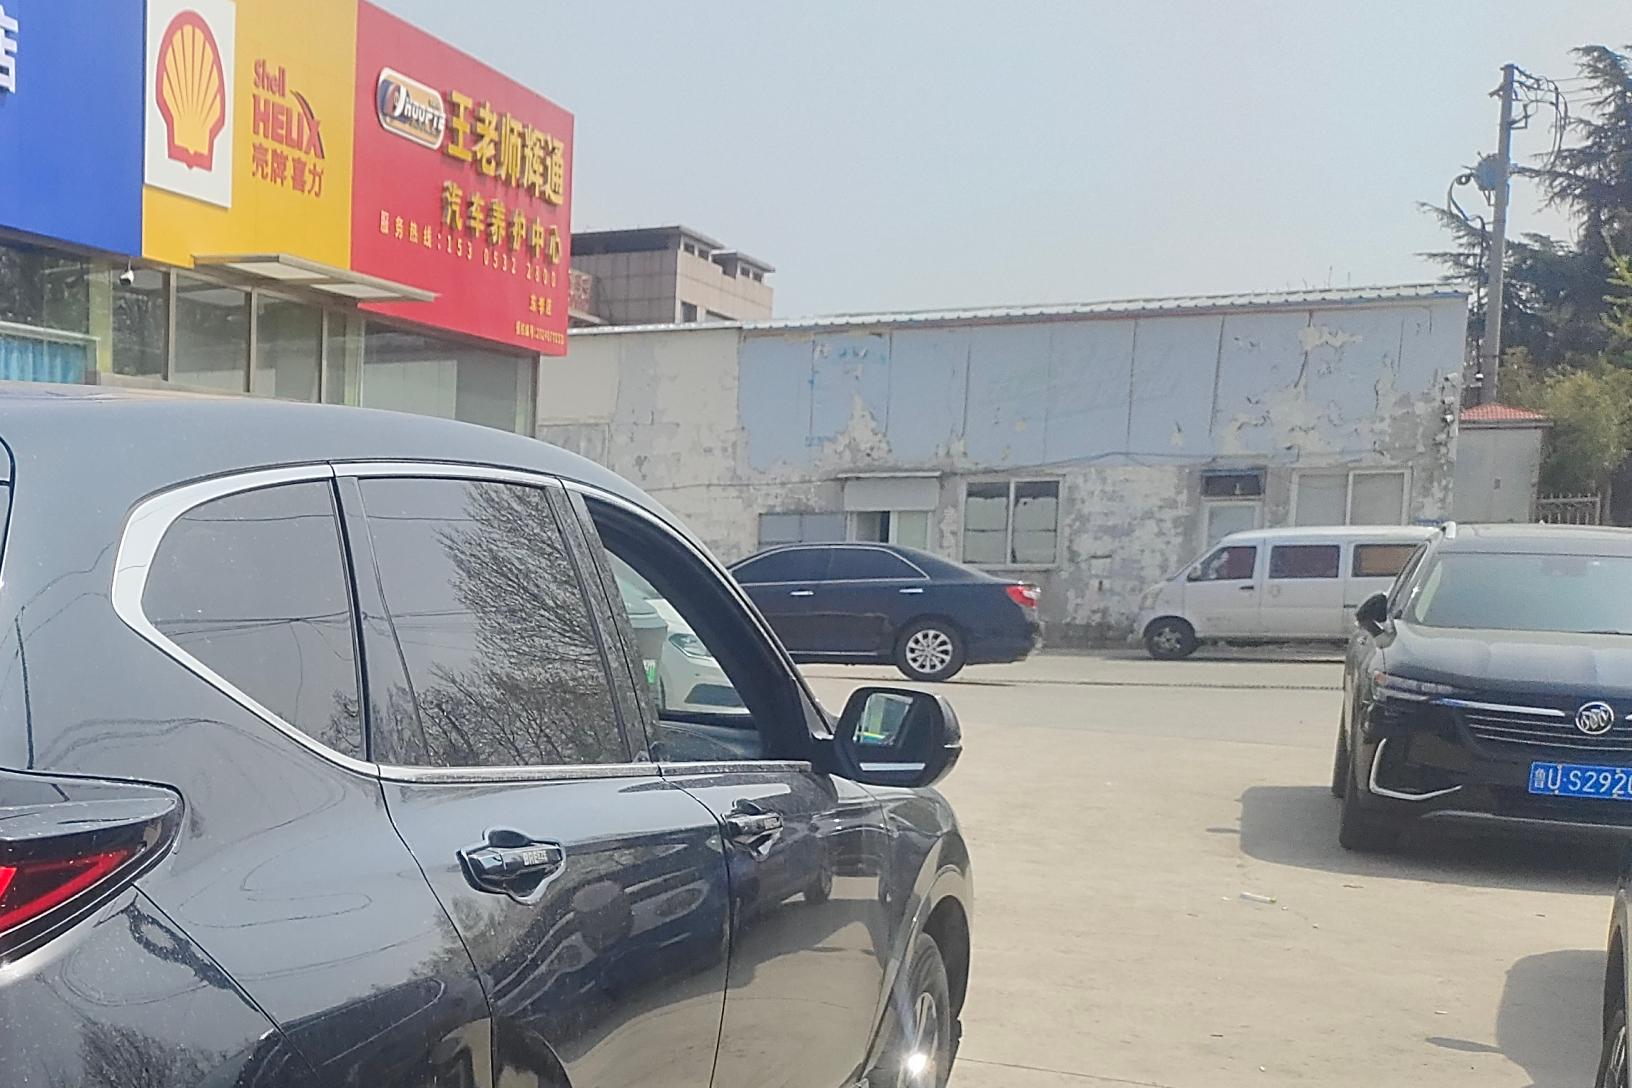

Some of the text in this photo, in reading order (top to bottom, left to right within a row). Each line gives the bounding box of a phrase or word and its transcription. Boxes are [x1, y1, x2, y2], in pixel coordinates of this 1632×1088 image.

[253, 58, 287, 99] Shell
[252, 92, 325, 160] HELIX
[447, 89, 565, 206] 王老师辉通
[442, 180, 562, 266] 汽车养护中心
